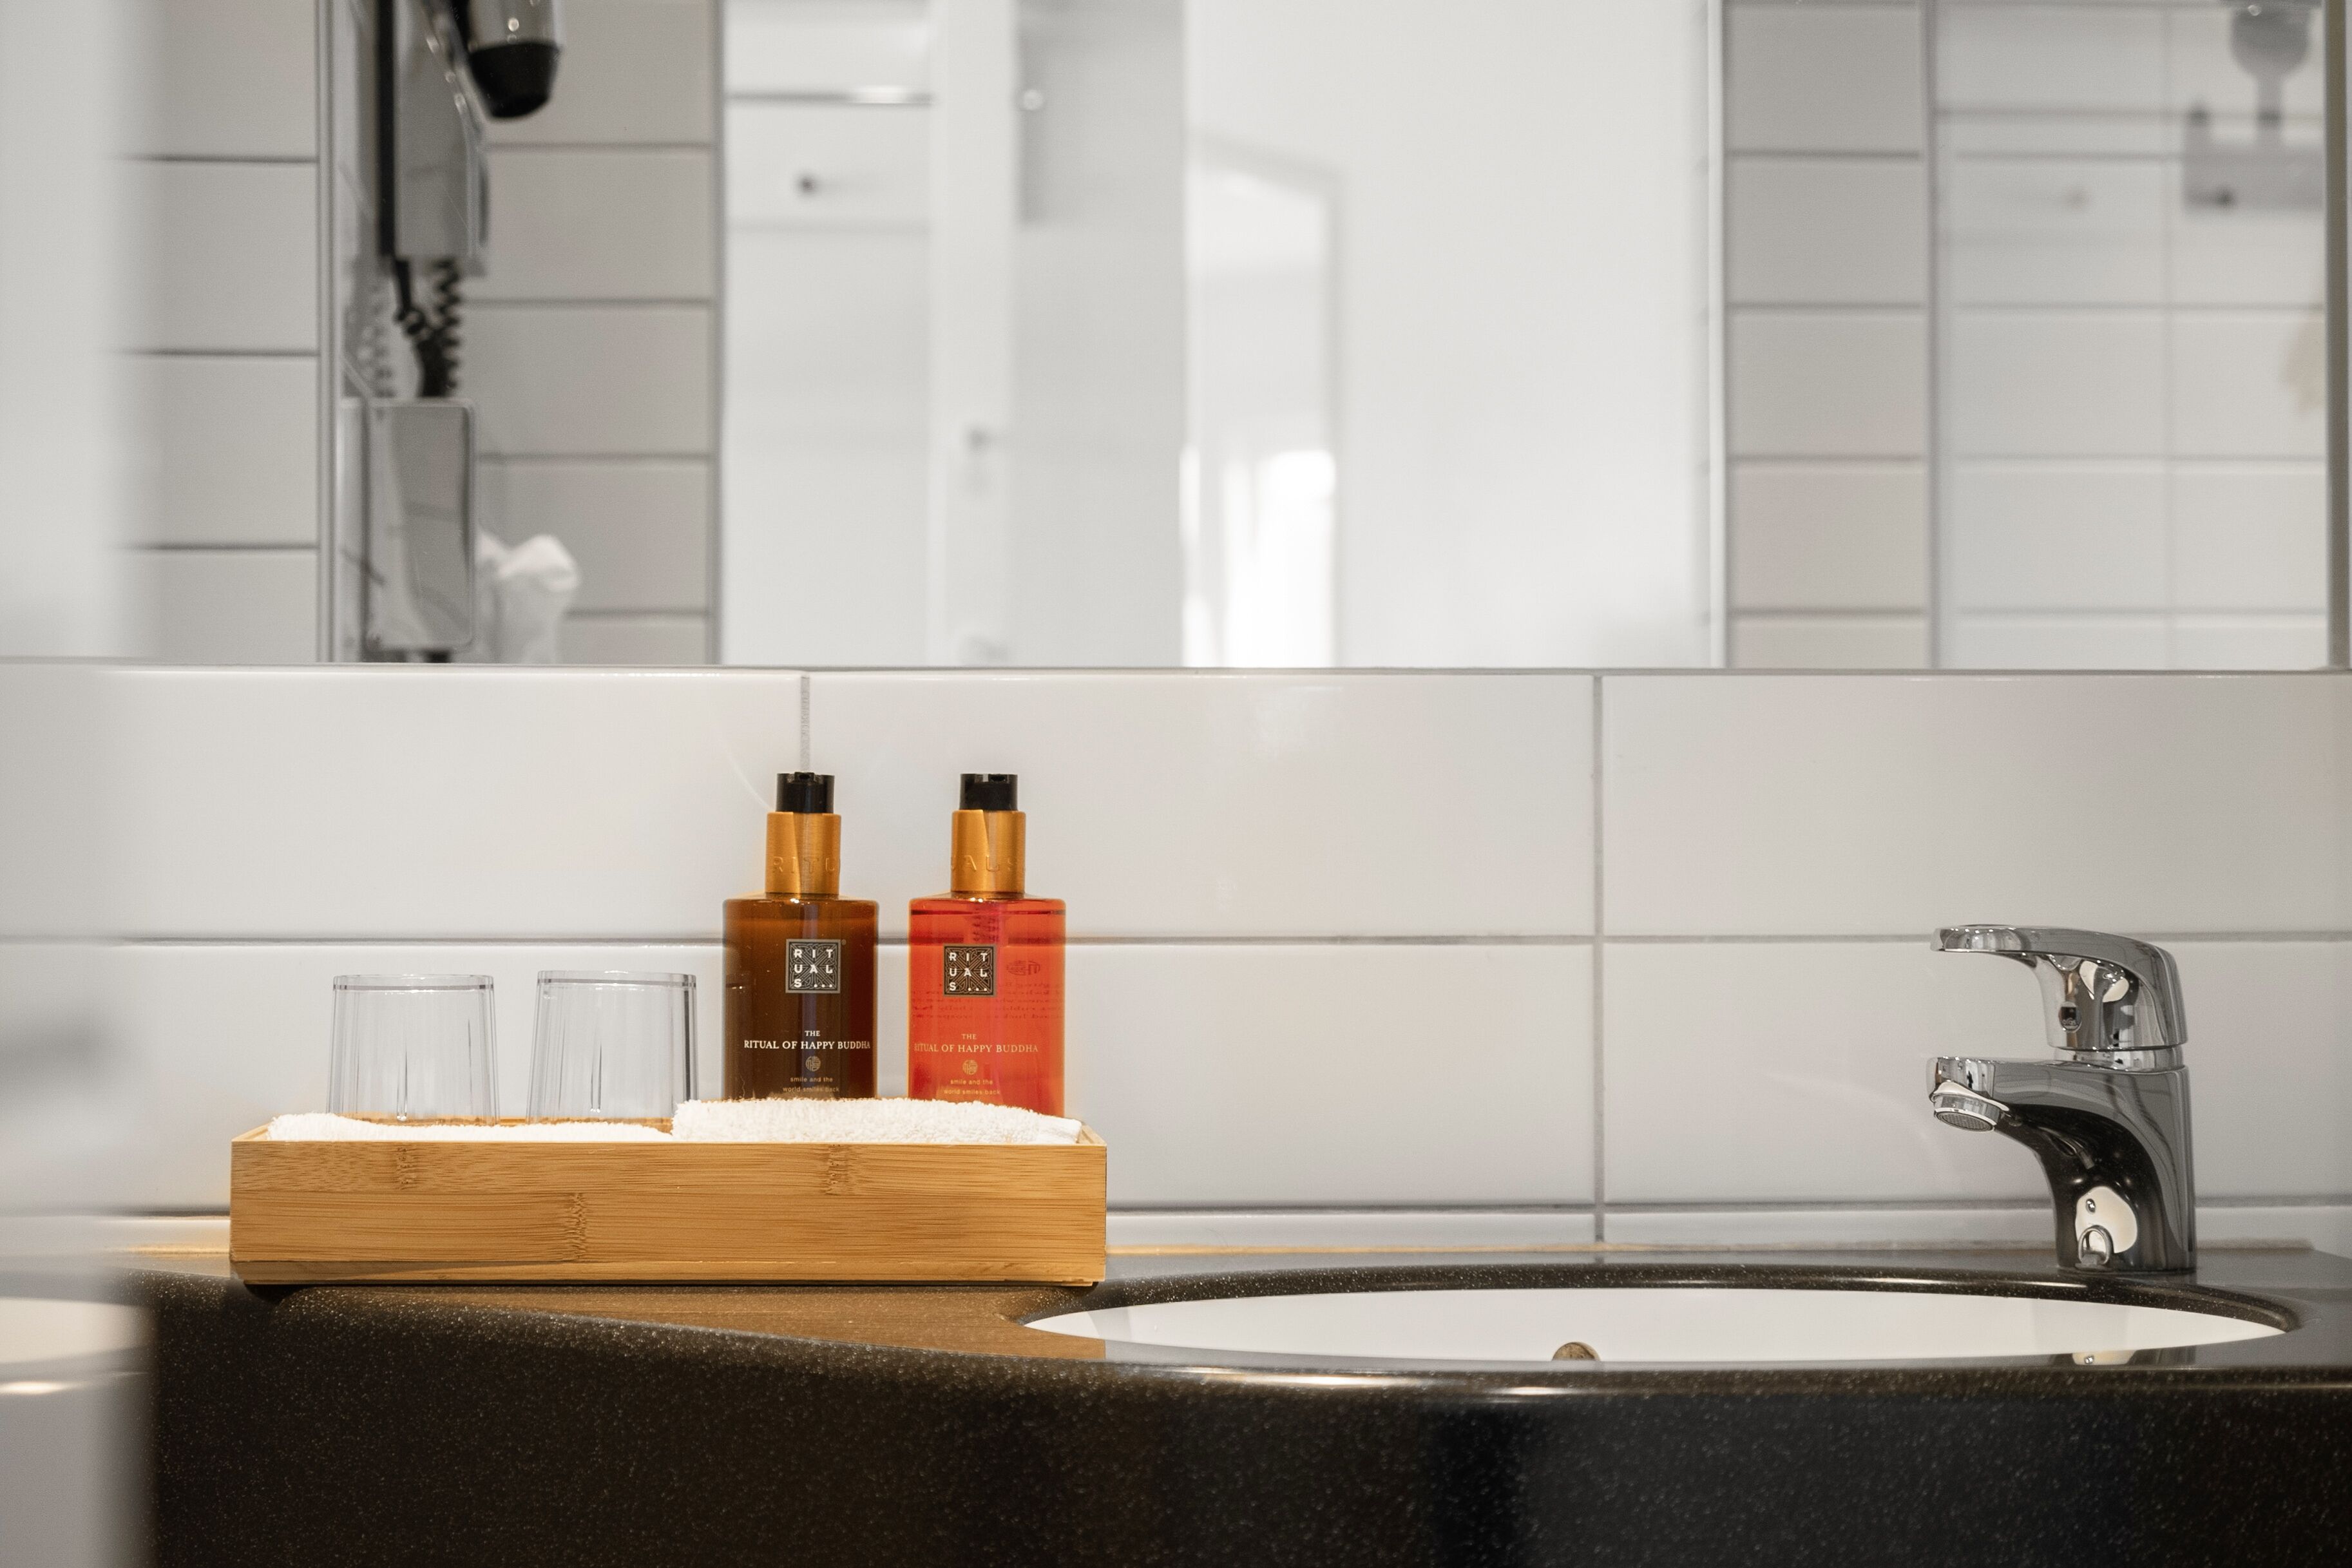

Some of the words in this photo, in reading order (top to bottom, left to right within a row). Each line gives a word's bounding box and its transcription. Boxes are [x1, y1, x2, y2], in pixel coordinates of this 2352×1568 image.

[744, 1040, 779, 1049] RITUAL
[782, 1041, 798, 1049] OF
[801, 1041, 835, 1049] HAPPY
[837, 1041, 870, 1049] BUDDHA
[913, 1043, 939, 1052] RITUAL
[958, 1044, 992, 1053] HAPPY
